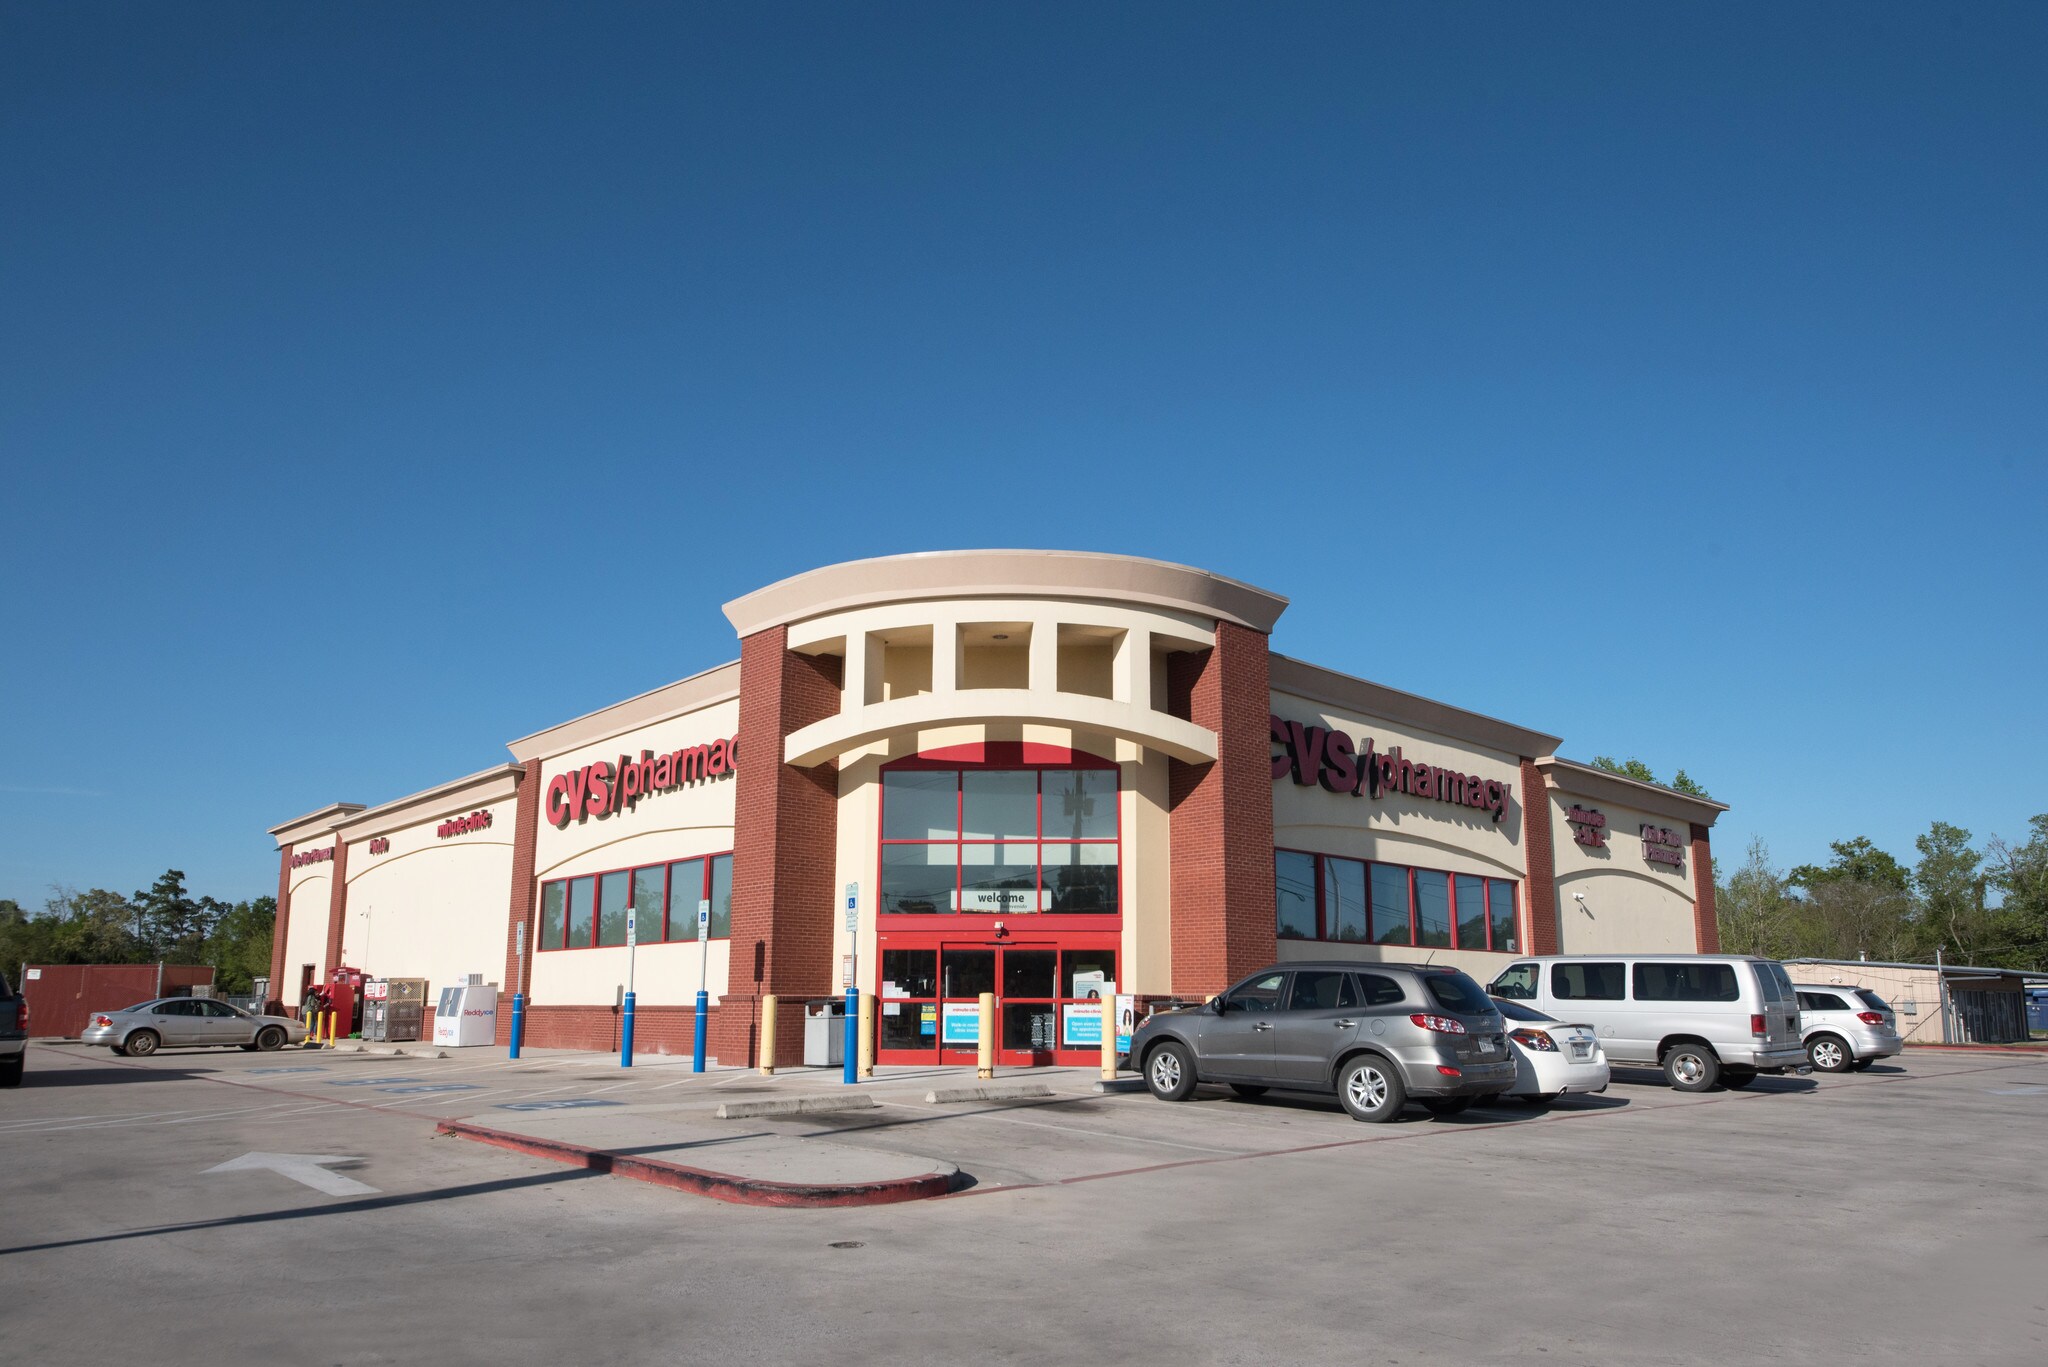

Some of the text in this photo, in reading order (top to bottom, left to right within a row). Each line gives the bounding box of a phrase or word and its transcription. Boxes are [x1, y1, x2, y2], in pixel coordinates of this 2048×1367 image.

[546, 734, 738, 826] CVS/pharmac
[437, 811, 489, 838] minute clinic
[978, 892, 1025, 903] welcome
